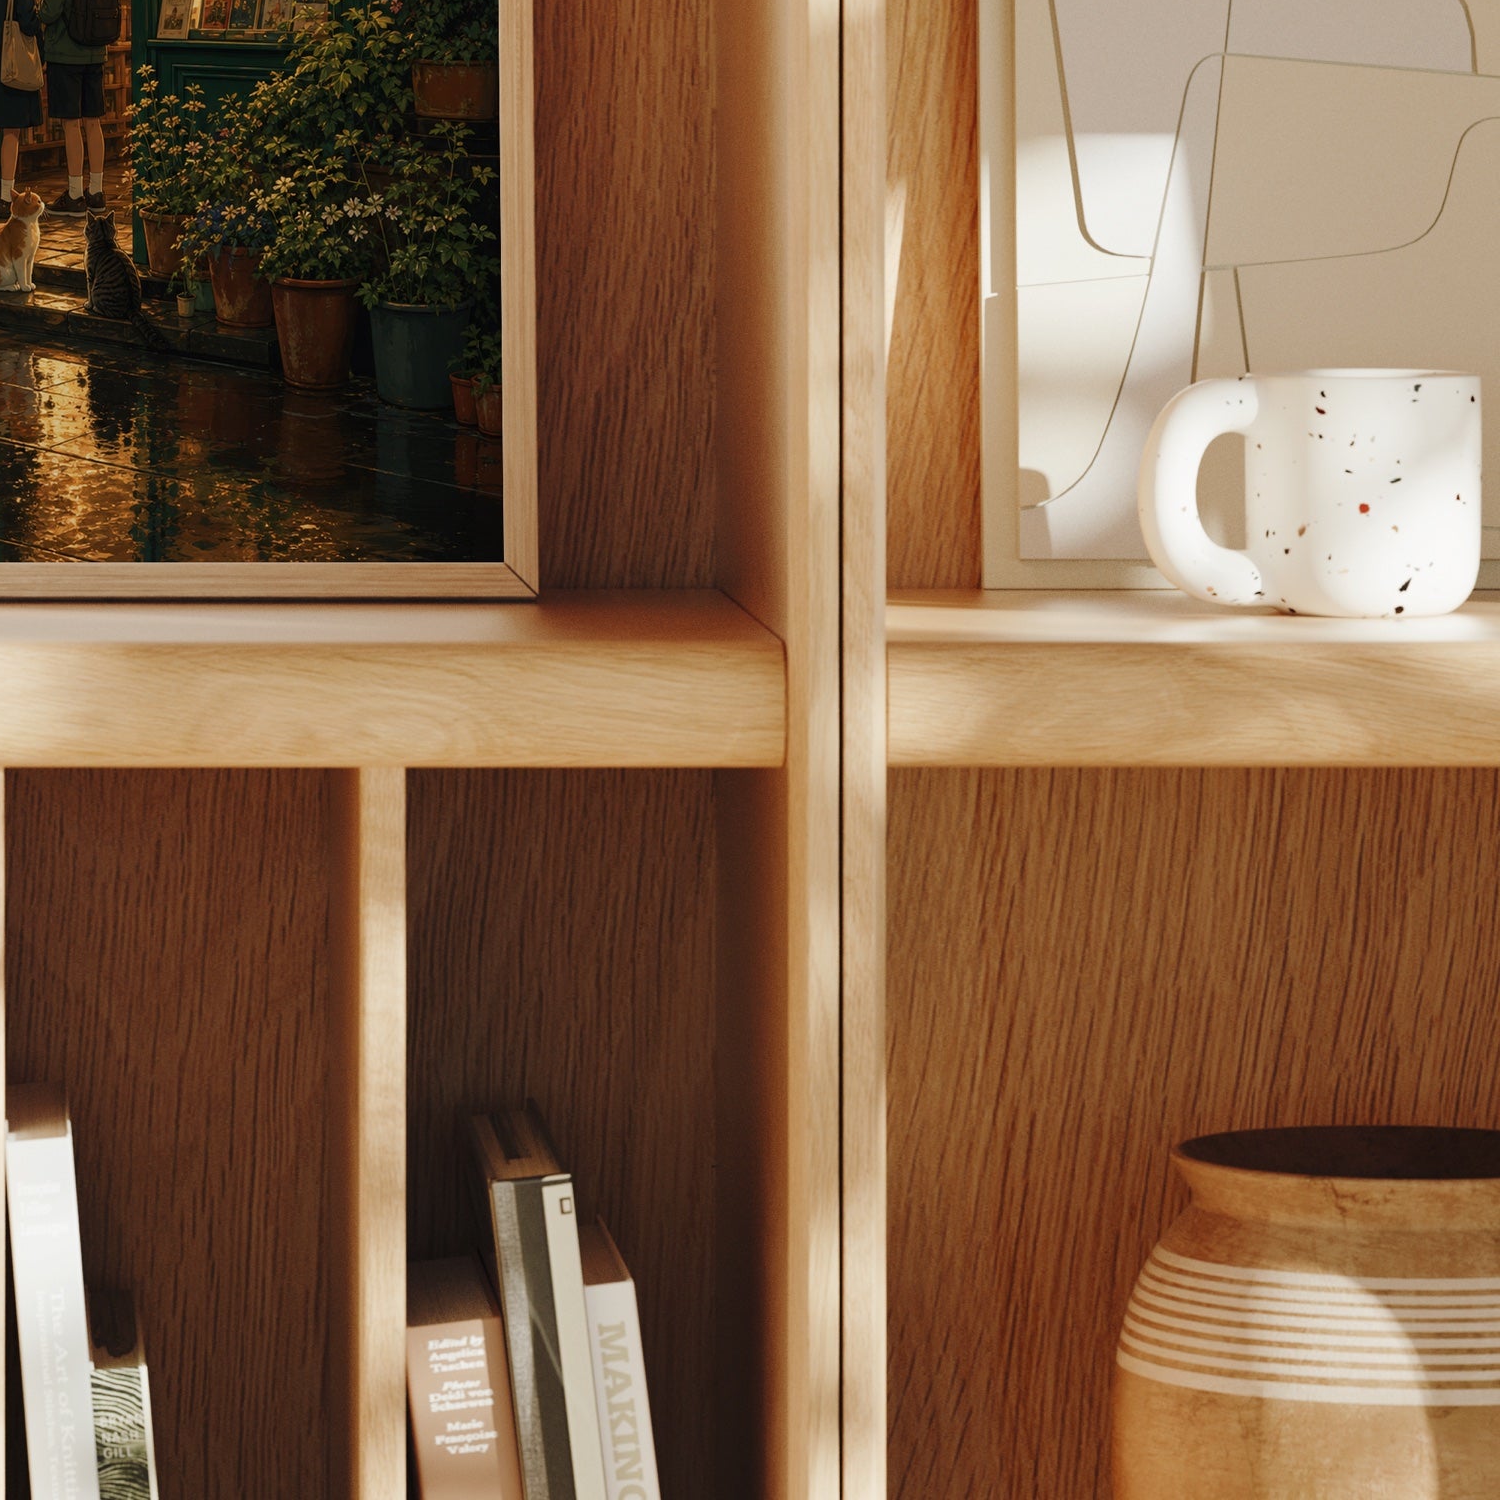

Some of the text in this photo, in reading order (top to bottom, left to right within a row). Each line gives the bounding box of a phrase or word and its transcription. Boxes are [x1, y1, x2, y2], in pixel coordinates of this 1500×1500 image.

[56, 1344, 69, 1385] Art
[60, 1390, 76, 1420] of
[103, 1445, 132, 1460] GILL
